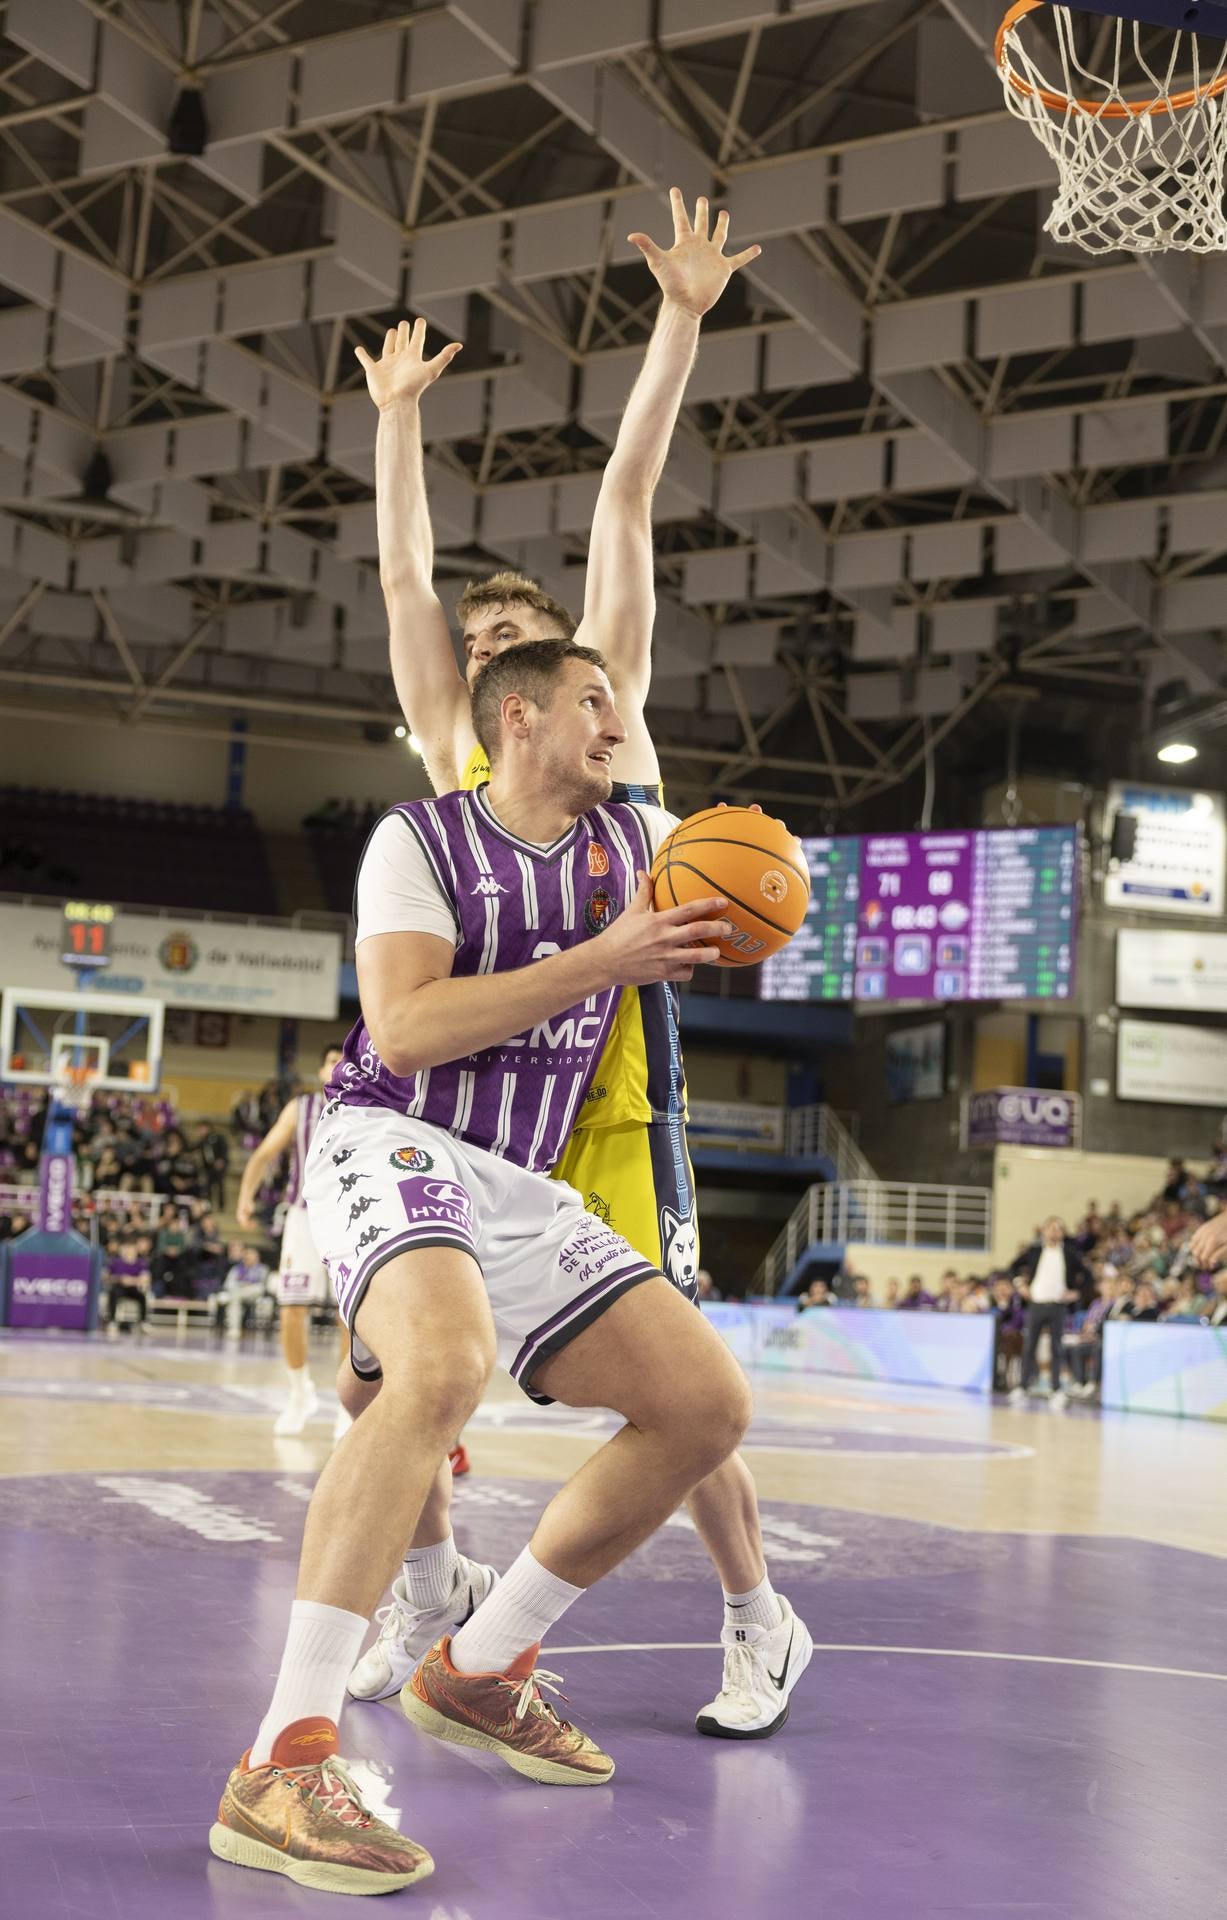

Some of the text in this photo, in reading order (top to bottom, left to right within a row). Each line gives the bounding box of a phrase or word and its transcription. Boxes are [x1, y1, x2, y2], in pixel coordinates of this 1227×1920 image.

[70, 922, 104, 954] 11
[236, 951, 325, 976] Valladolid
[468, 1055, 593, 1065] NIVERSIDAD
[411, 1205, 473, 1232] HYUN
[563, 1258, 581, 1274] DE
[595, 1249, 619, 1273] gusto
[13, 1277, 89, 1298] IVECO
